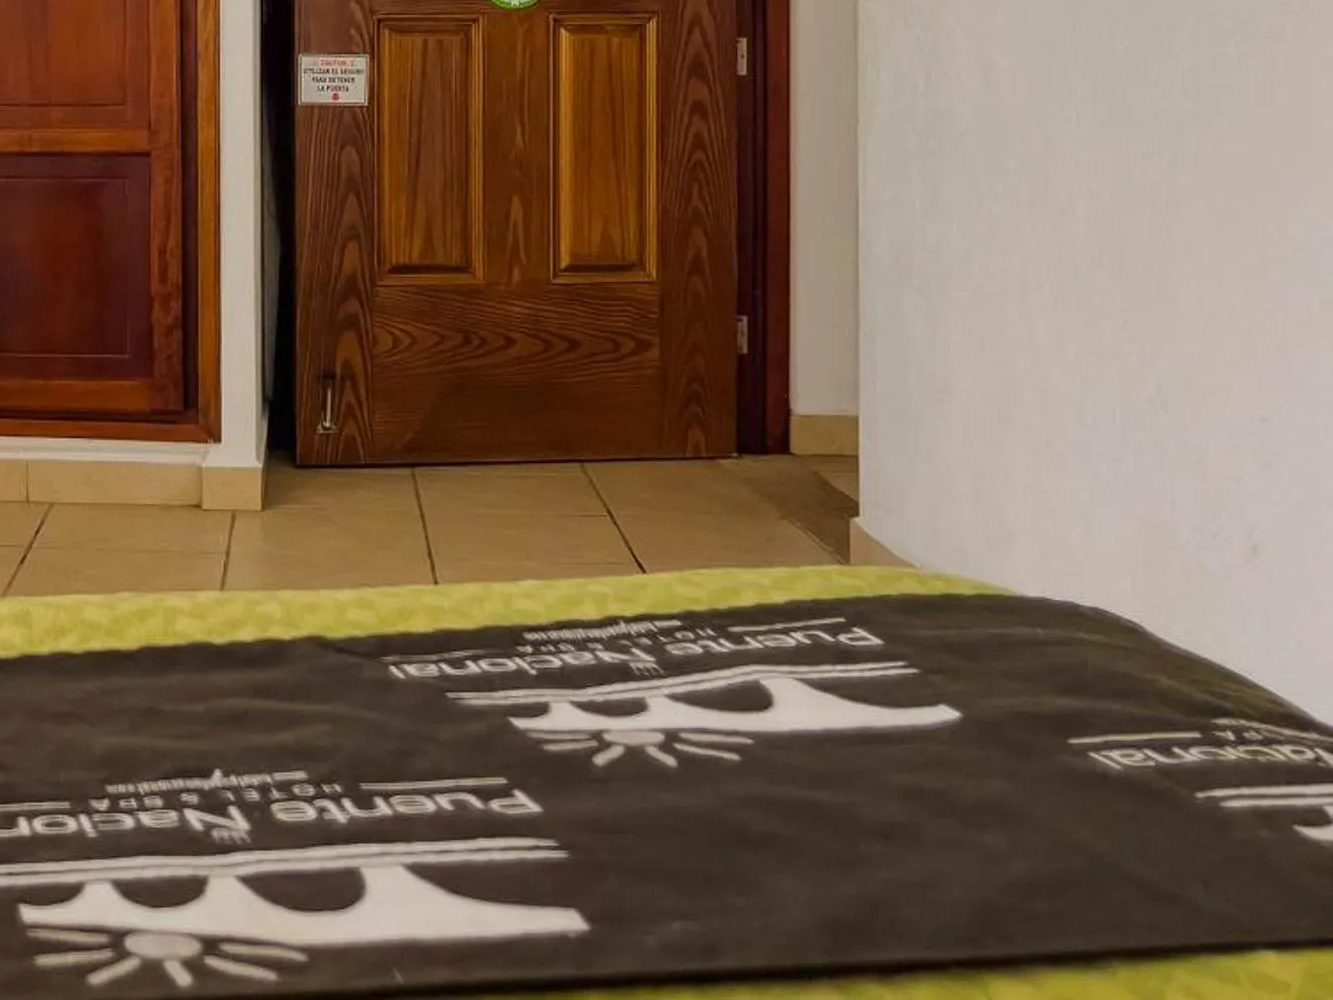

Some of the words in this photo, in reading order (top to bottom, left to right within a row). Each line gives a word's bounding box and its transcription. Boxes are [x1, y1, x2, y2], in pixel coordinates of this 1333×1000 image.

[665, 627, 885, 656] Puente
[388, 647, 656, 679] Nacional
[220, 783, 344, 802] HOTEL
[269, 788, 544, 824] Puente
